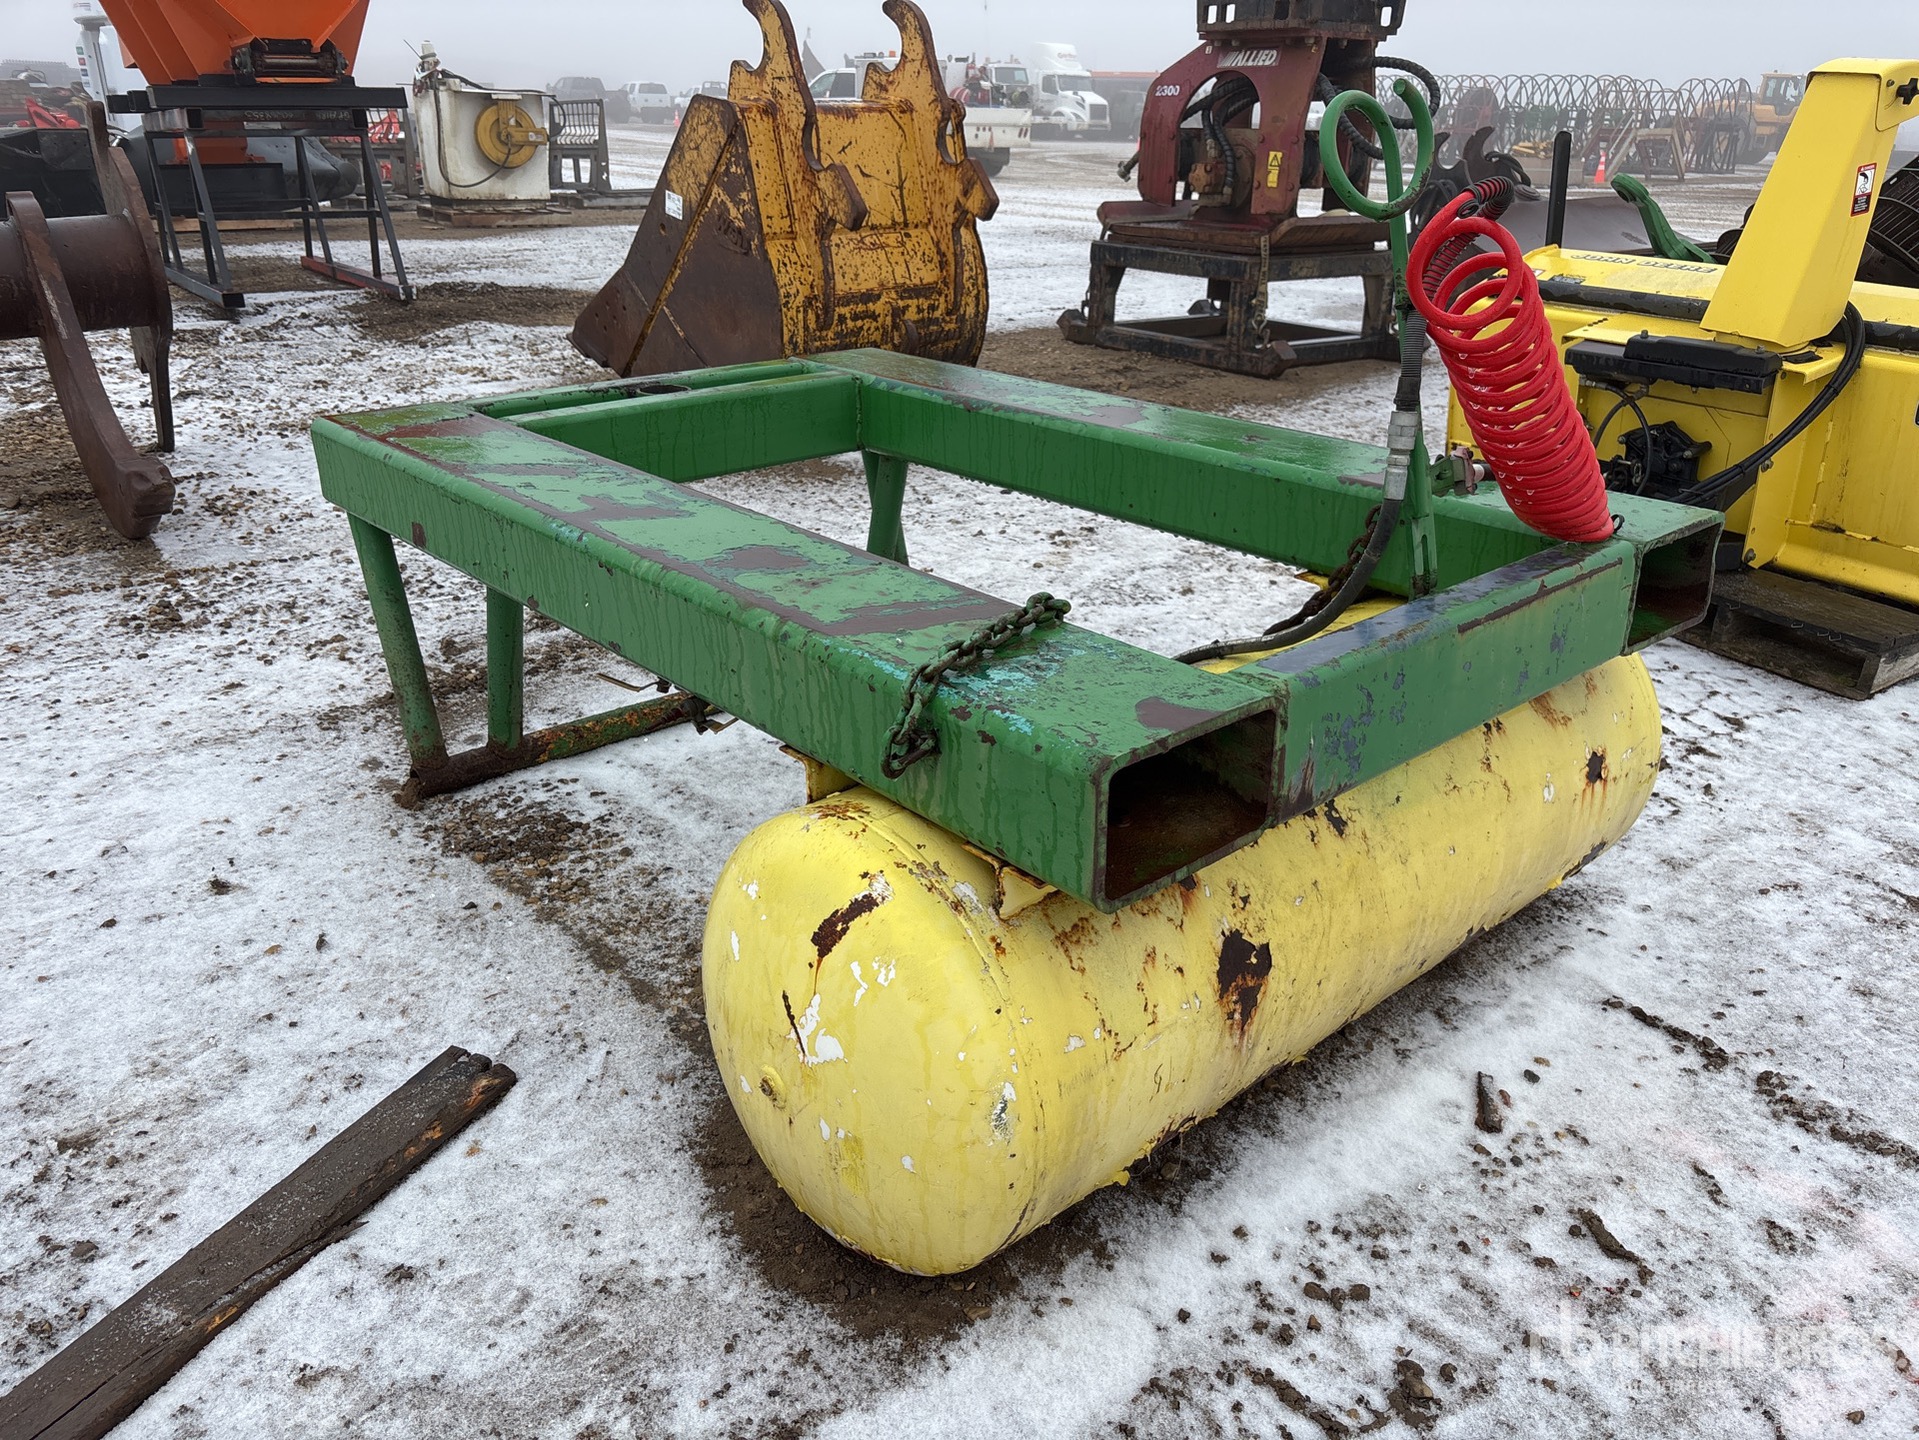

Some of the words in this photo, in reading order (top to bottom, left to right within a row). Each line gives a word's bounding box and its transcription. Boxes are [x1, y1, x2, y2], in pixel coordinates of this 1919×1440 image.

[1232, 49, 1278, 66] ALLIED
[1155, 85, 1180, 96] 2300
[1570, 254, 1636, 265] JOHN
[1637, 260, 1718, 274] DEERE
